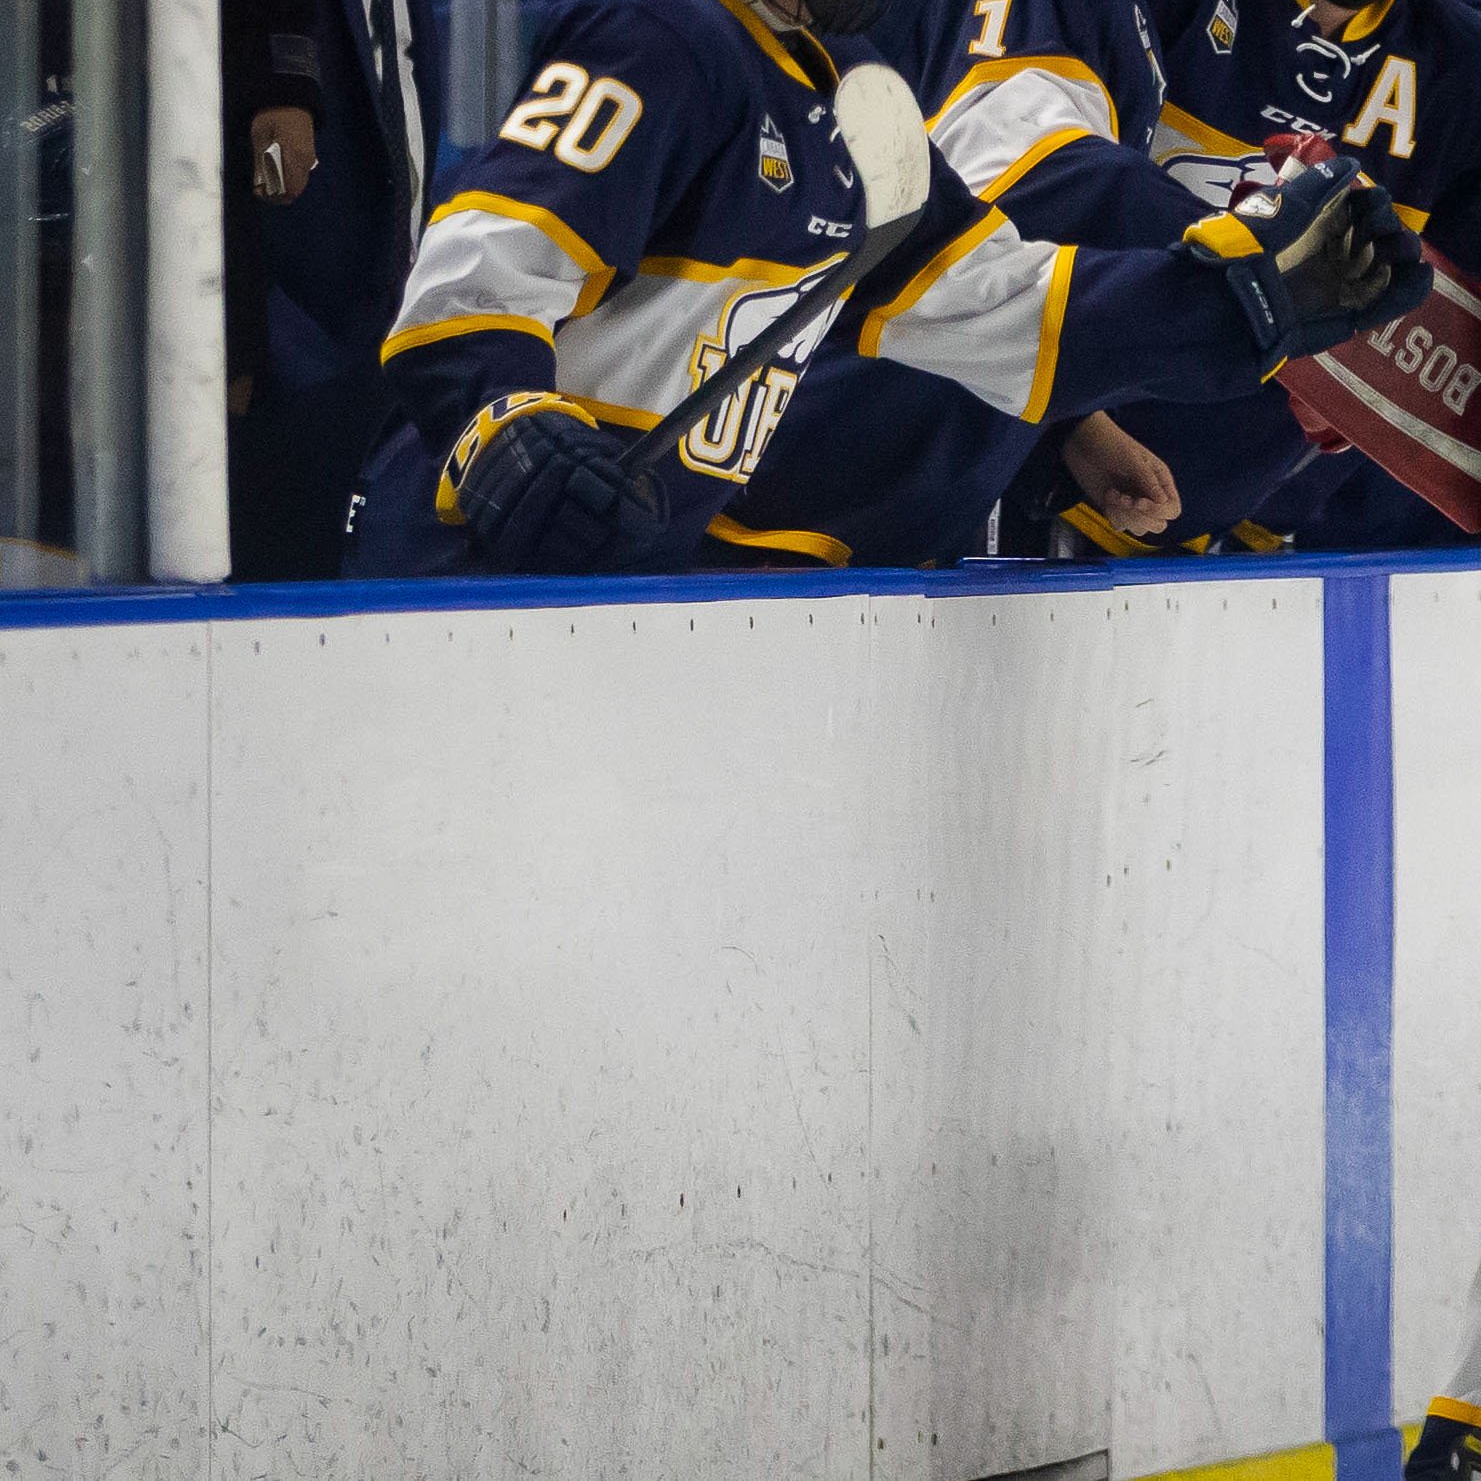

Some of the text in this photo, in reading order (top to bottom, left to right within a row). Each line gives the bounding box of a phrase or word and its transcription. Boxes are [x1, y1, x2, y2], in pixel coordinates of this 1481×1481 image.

[499, 61, 644, 174] 20
[1341, 55, 1418, 160] A
[808, 214, 853, 238] CC
